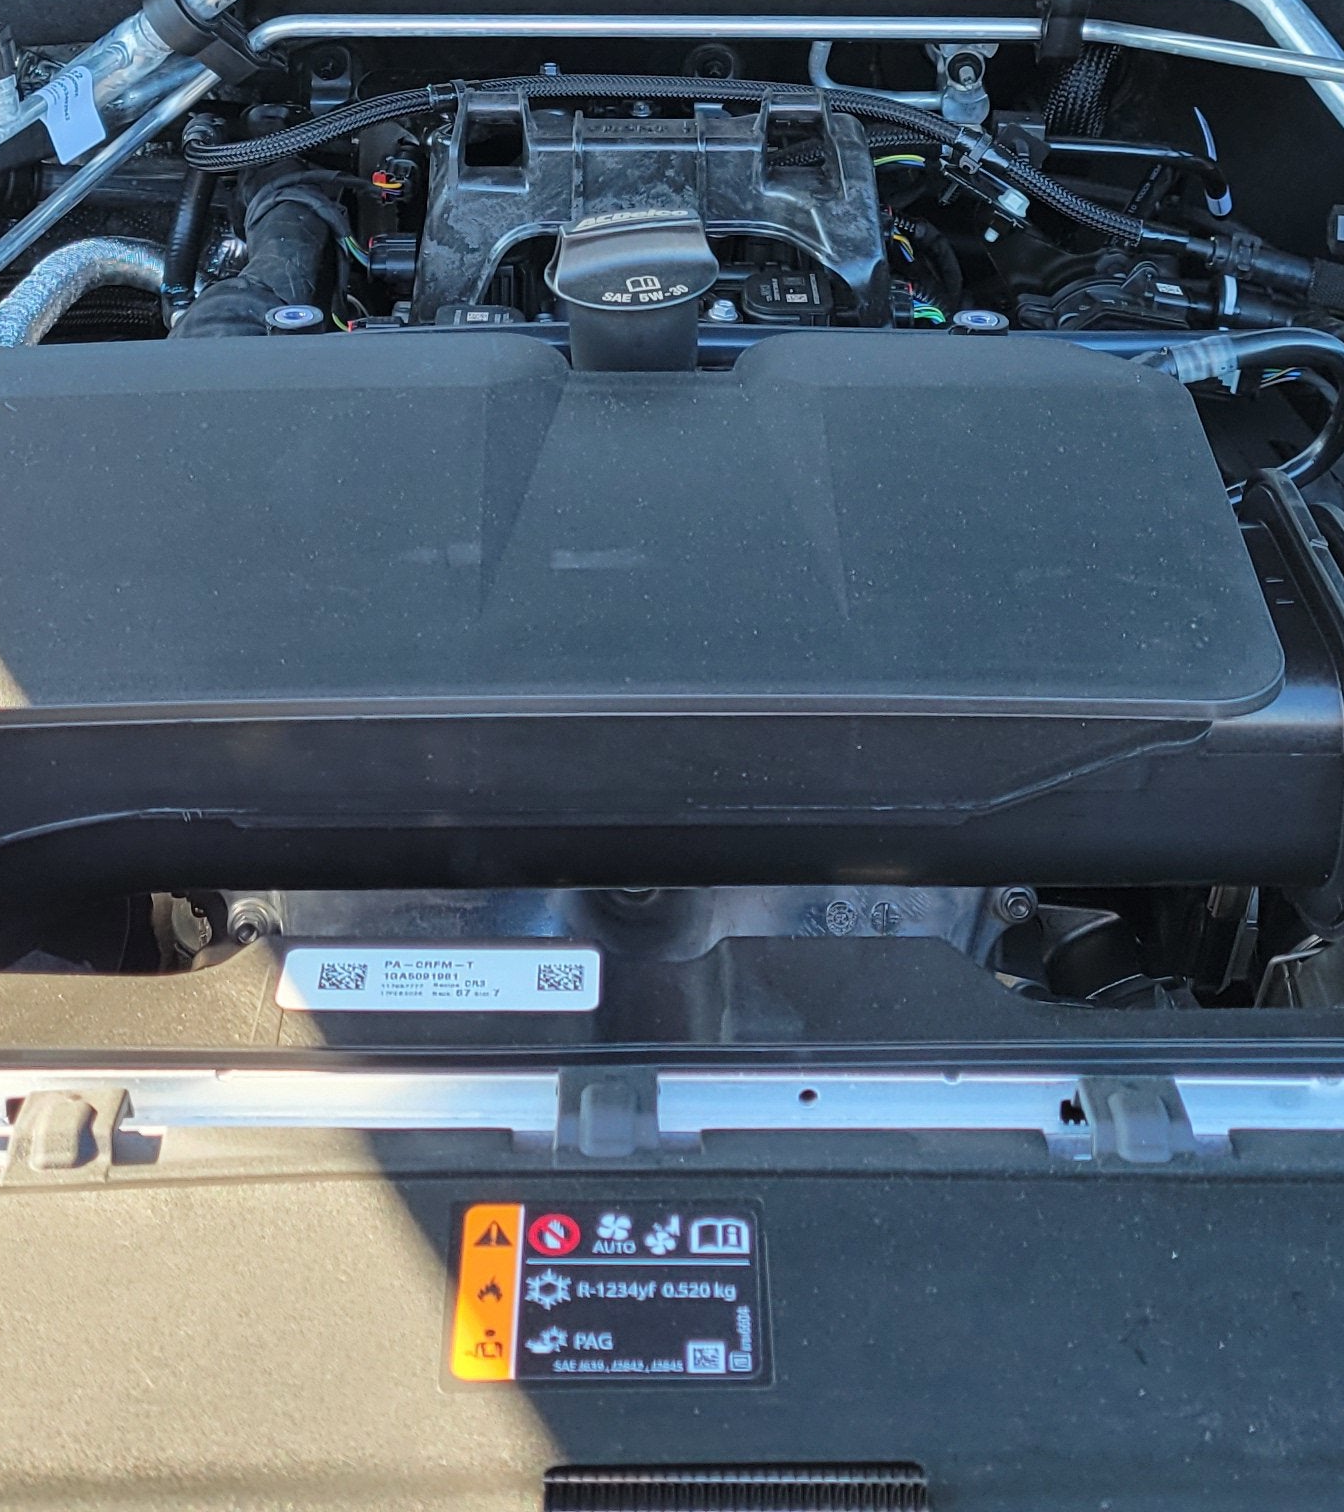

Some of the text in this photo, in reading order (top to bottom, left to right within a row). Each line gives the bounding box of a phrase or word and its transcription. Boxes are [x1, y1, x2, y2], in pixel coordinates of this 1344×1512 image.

[575, 209, 689, 229] ACDelco
[602, 284, 689, 303] SAE 5W-30
[592, 1240, 636, 1254] AUTO
[576, 1281, 737, 1301] R-1234yf 0.520 kg
[573, 1332, 613, 1350] PAG
[553, 1360, 576, 1372] SAE
